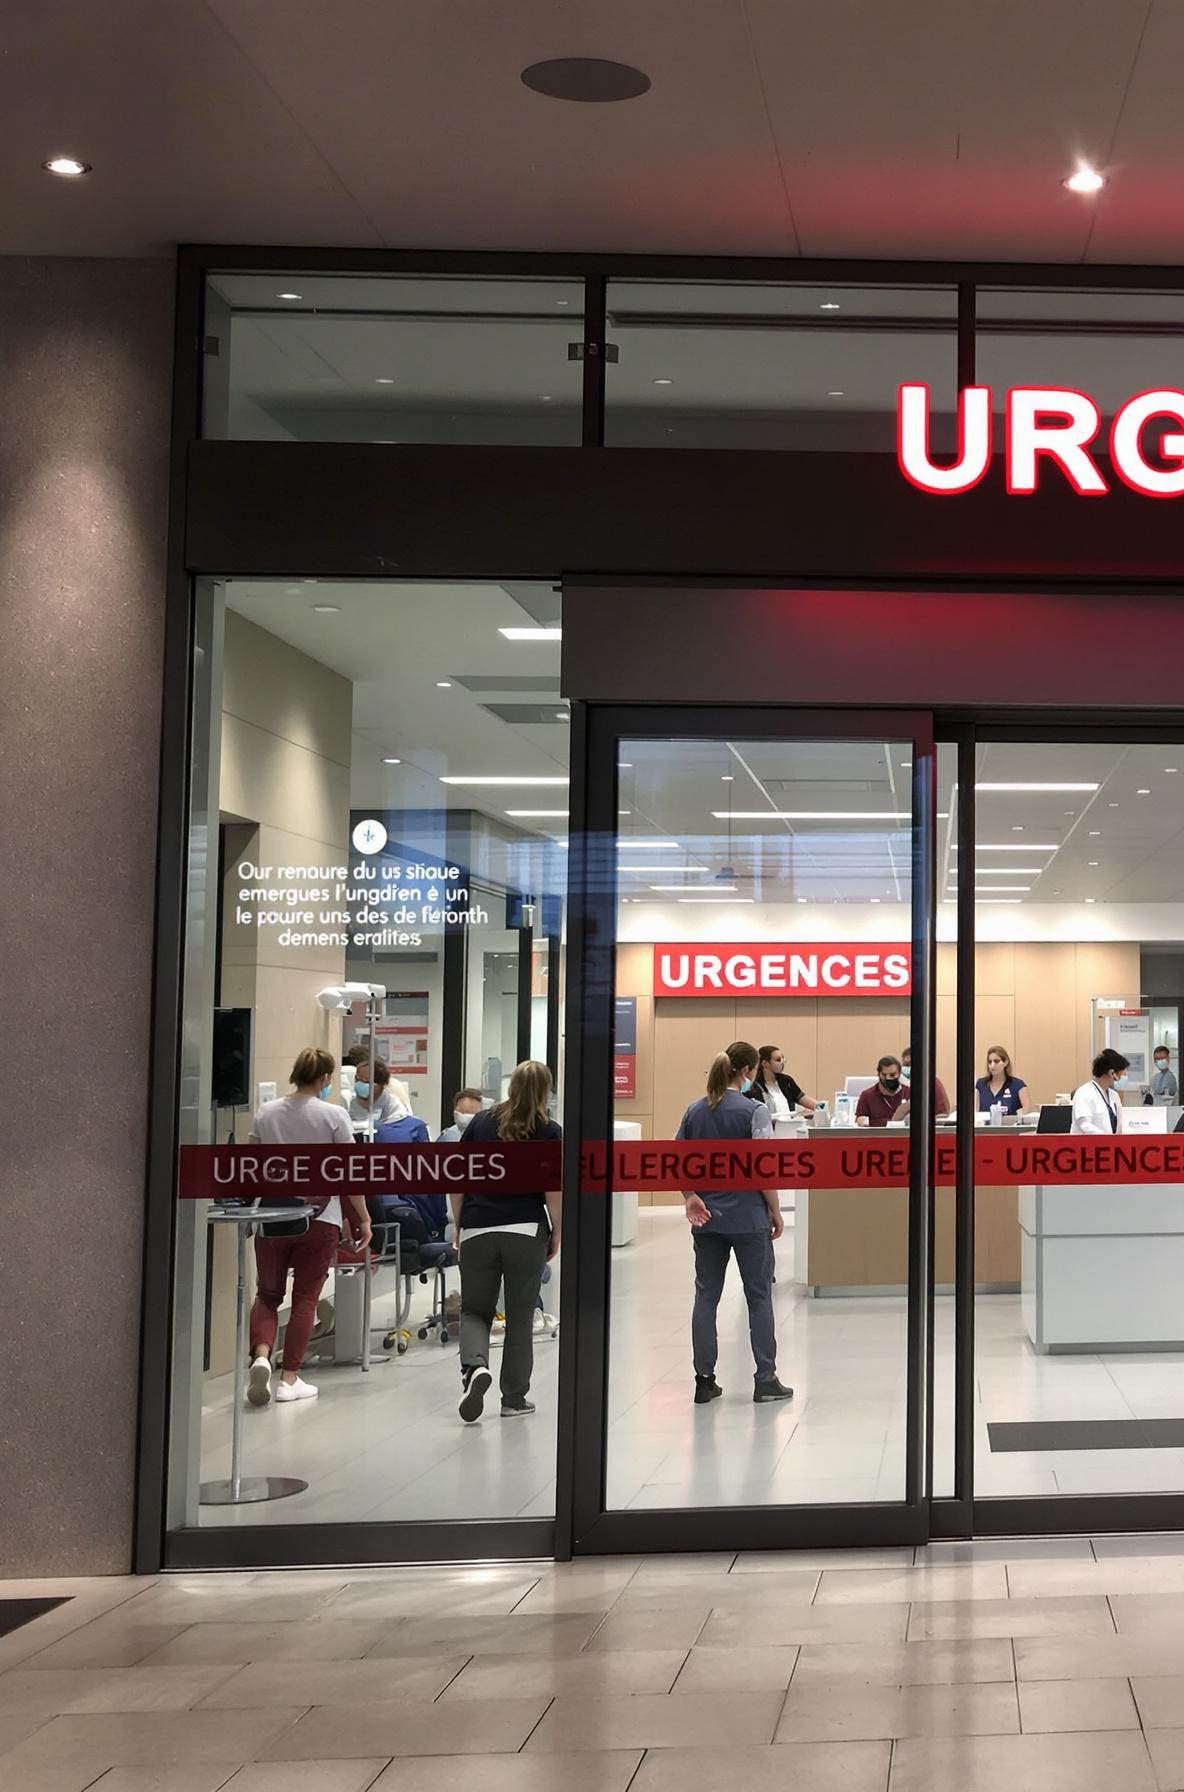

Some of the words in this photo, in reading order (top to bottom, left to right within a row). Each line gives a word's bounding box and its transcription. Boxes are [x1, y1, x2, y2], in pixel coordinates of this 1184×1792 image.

[238, 862, 273, 880] Our
[353, 860, 376, 880] du
[382, 866, 401, 880] us
[239, 889, 330, 906] emergues
[446, 888, 468, 901] un
[236, 905, 253, 924] le
[319, 910, 351, 924] uns
[356, 905, 389, 924] des
[394, 905, 417, 924] de
[278, 928, 349, 946] demens
[660, 954, 909, 988] URGENCES
[213, 1156, 311, 1184] URGE
[319, 1153, 506, 1182] GEENNCES
